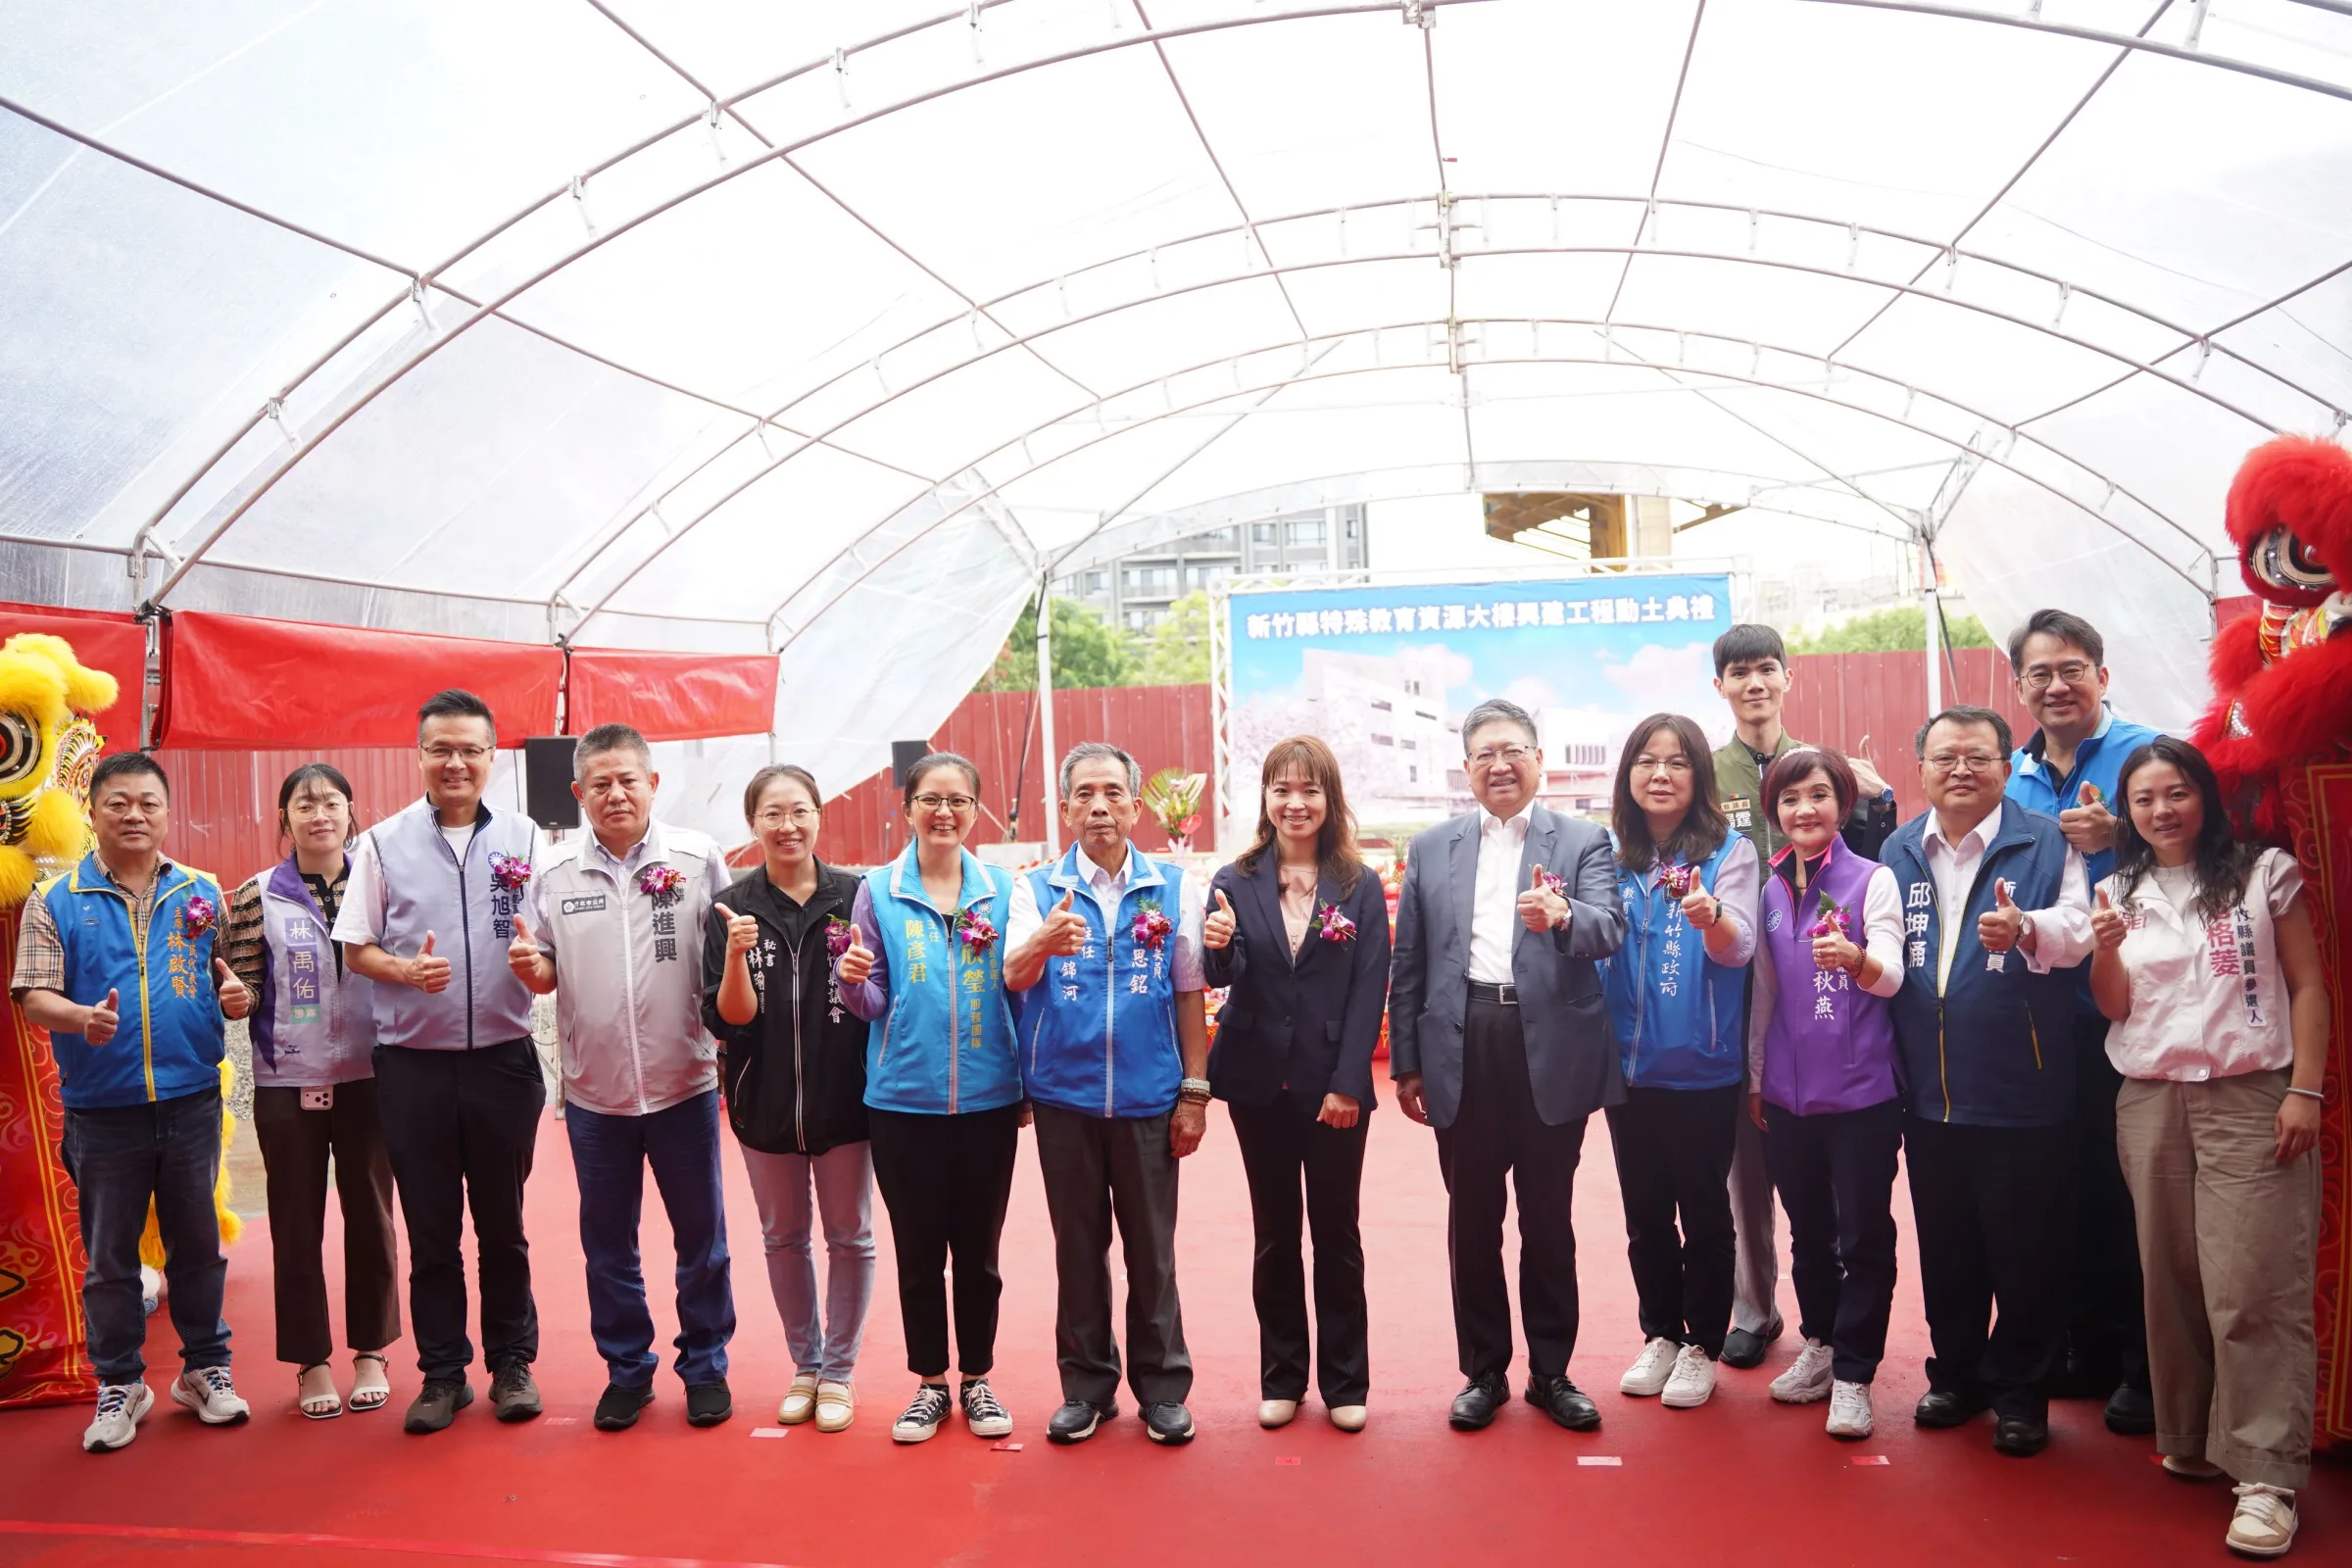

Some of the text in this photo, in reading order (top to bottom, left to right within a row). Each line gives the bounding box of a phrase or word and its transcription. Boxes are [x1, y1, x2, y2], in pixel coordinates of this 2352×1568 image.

[1247, 594, 1715, 639] 新竹縣特殊教育資源大樓興建工程動土典禮
[651, 893, 677, 963] 陳進興
[763, 939, 776, 967] 秘書
[905, 919, 928, 983] 陳彥君
[926, 919, 941, 943] 主任
[1082, 926, 1096, 959] 主任
[1659, 901, 1684, 997] 新竹縣政府
[290, 919, 316, 1000] 林禹佑
[1060, 960, 1079, 1002] 錦河
[1812, 963, 1838, 1020] 秋燕
